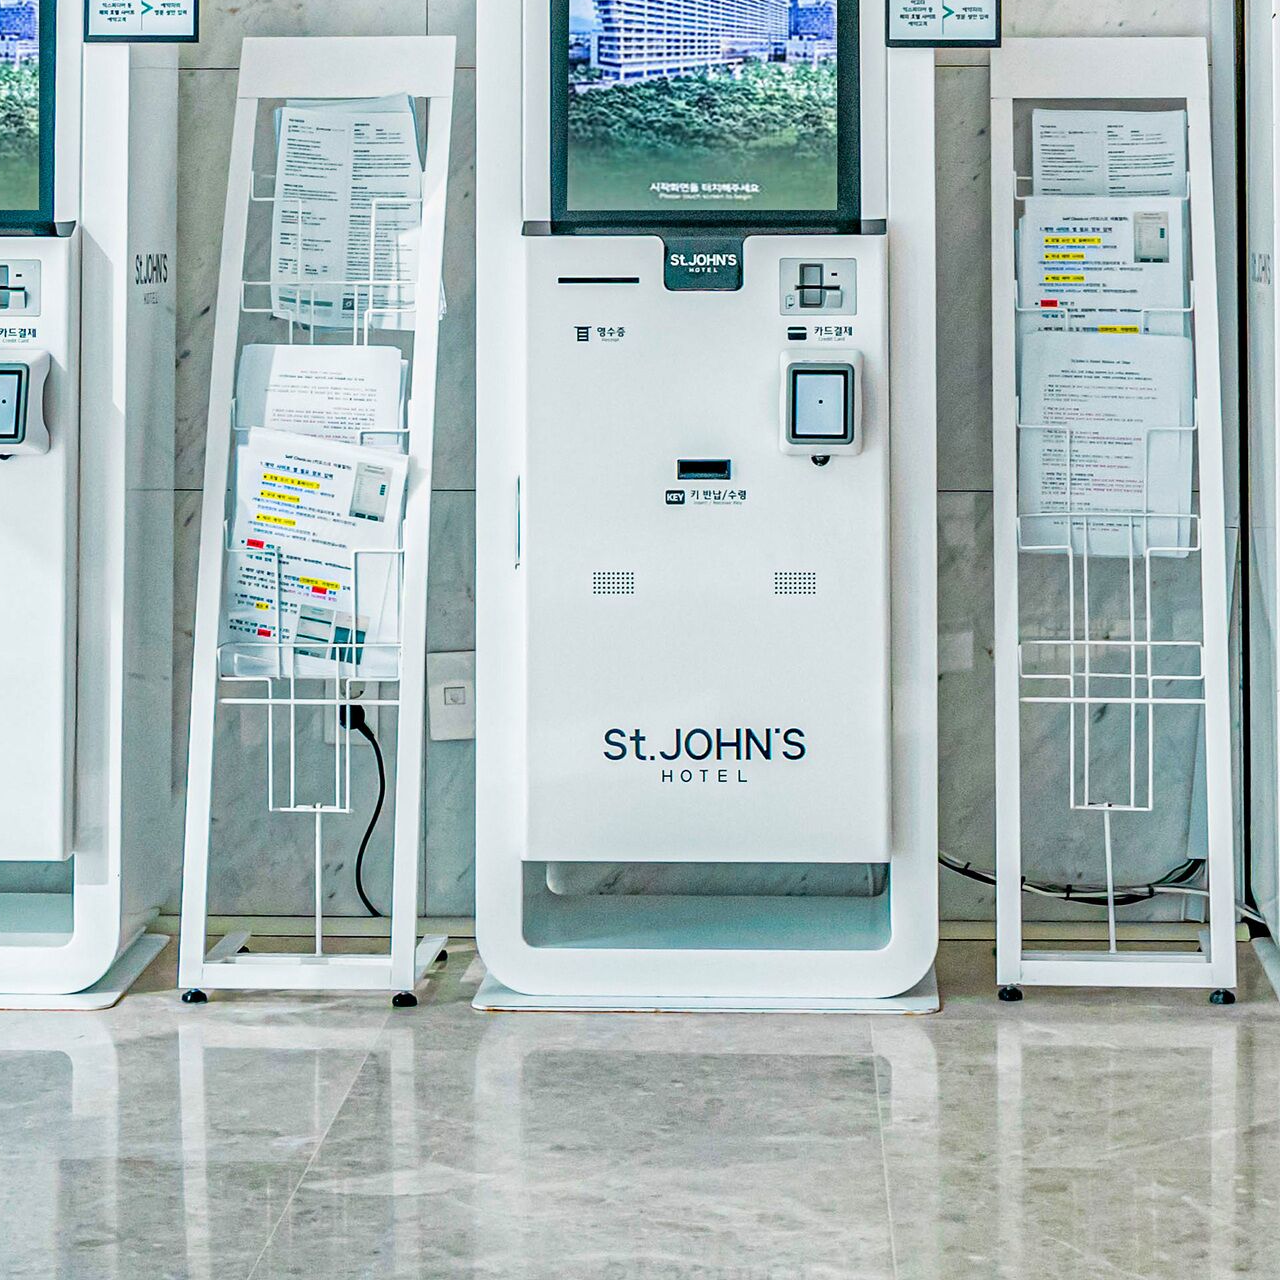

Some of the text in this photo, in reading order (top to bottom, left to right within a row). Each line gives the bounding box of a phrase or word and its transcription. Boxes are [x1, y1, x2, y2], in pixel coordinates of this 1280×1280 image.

[670, 253, 737, 267] St.JOHN'S
[596, 326, 626, 338] 영수증
[814, 326, 853, 337] 카드결제
[667, 493, 684, 501] KEY
[690, 489, 747, 501] 키 반납/수령
[603, 728, 807, 761] St.JOHN'S
[661, 769, 748, 782] HOTEL
